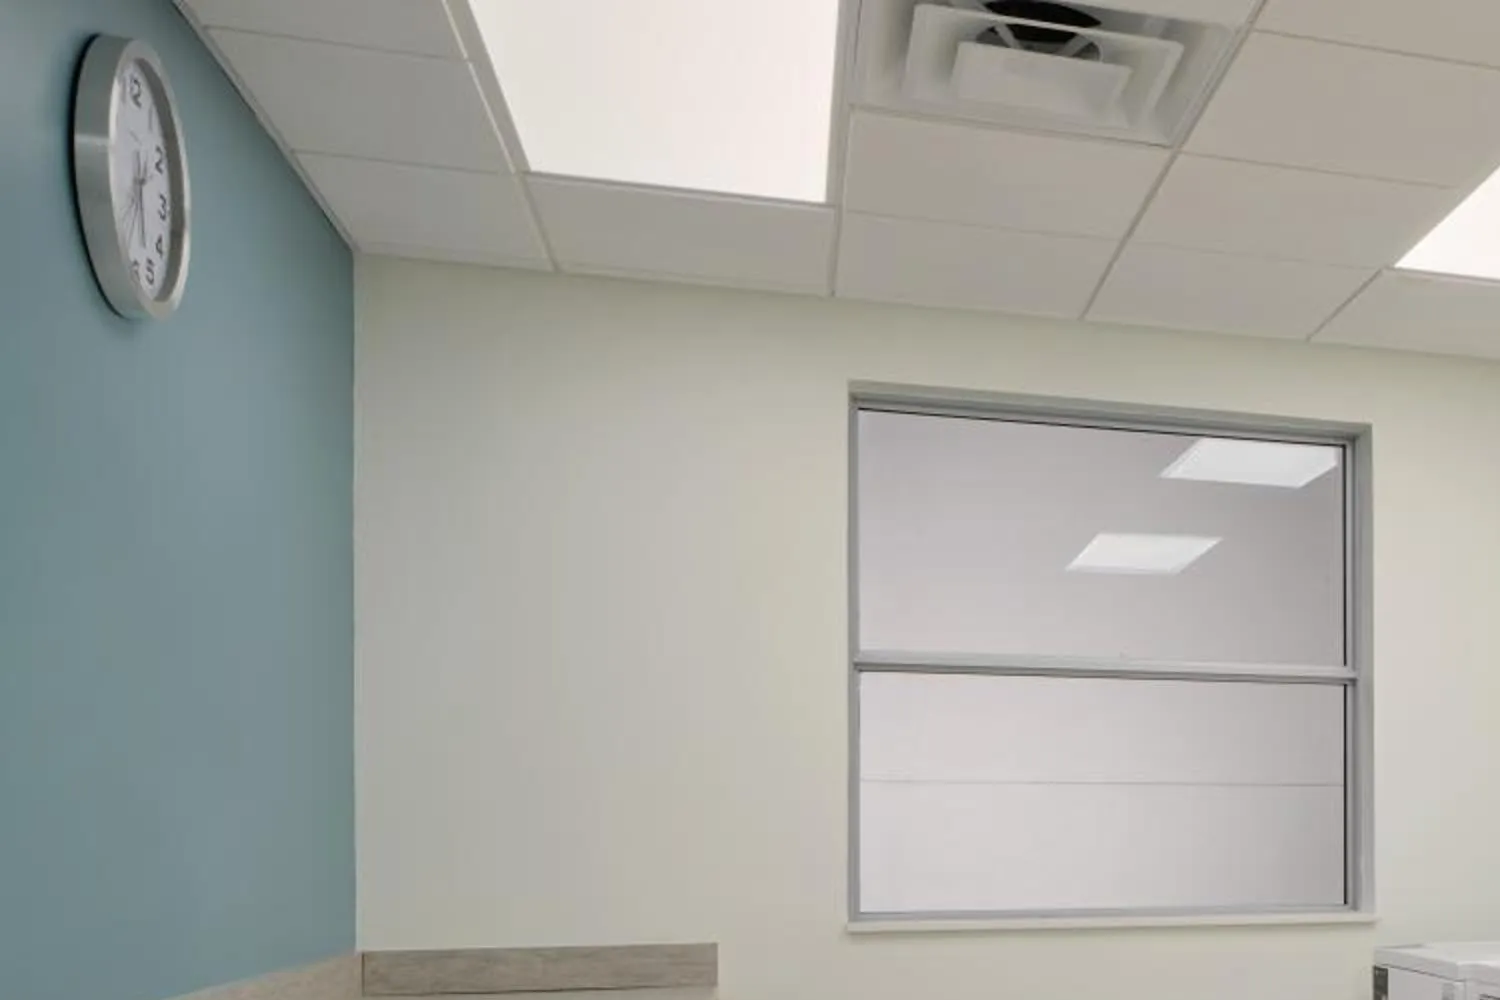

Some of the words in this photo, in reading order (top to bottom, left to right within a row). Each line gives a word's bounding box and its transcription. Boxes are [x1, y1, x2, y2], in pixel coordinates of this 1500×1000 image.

[155, 146, 163, 174] 2
[158, 193, 167, 221] 3
[145, 258, 155, 285] 5
